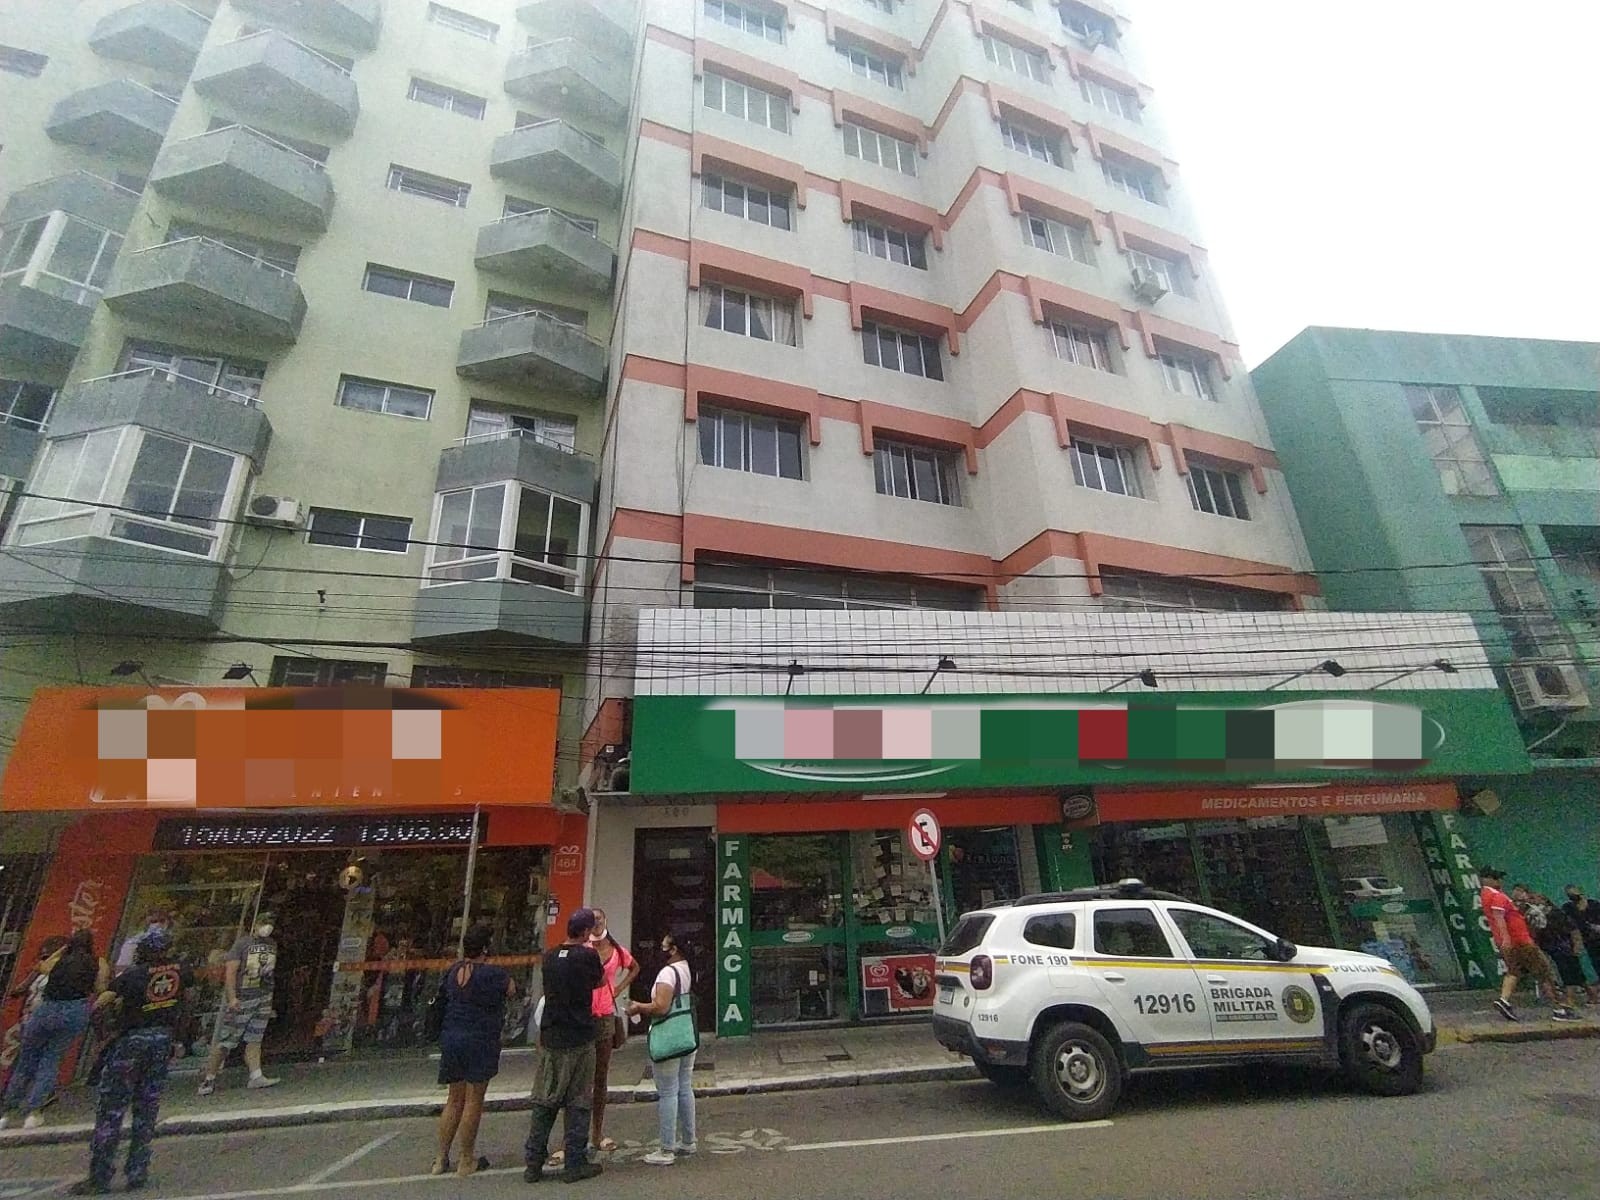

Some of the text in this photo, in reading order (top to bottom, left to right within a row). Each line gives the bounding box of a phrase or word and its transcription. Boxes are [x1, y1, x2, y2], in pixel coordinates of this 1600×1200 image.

[1201, 792, 1427, 809] MEDICAMENTOS E PERFUMARIA
[722, 840, 744, 1023] FARMÁCIA
[1010, 955, 1068, 966] FONE 190
[1210, 986, 1273, 999] BRIGADA
[1133, 993, 1196, 1015] 12916
[1213, 1000, 1277, 1012] MILITAR
[978, 1013, 999, 1023] 12916
